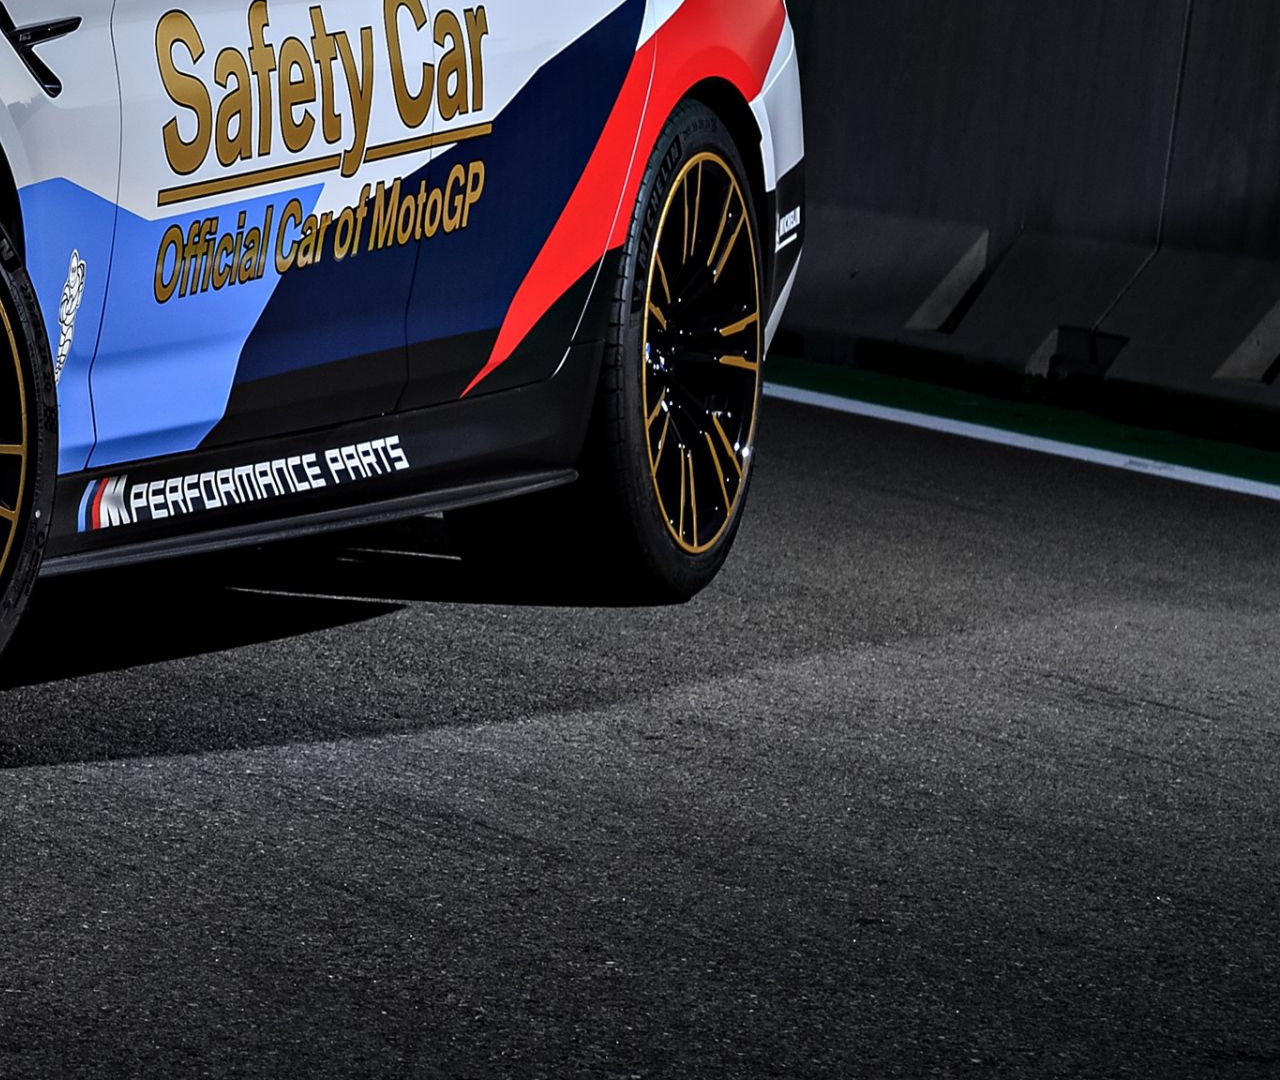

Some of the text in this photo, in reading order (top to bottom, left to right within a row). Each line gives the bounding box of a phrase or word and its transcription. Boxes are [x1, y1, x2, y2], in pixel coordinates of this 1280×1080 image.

[153, 160, 486, 304] Official Car of MotoGP
[129, 452, 327, 523] PERFORMANCE
[324, 434, 410, 484] PARTS
